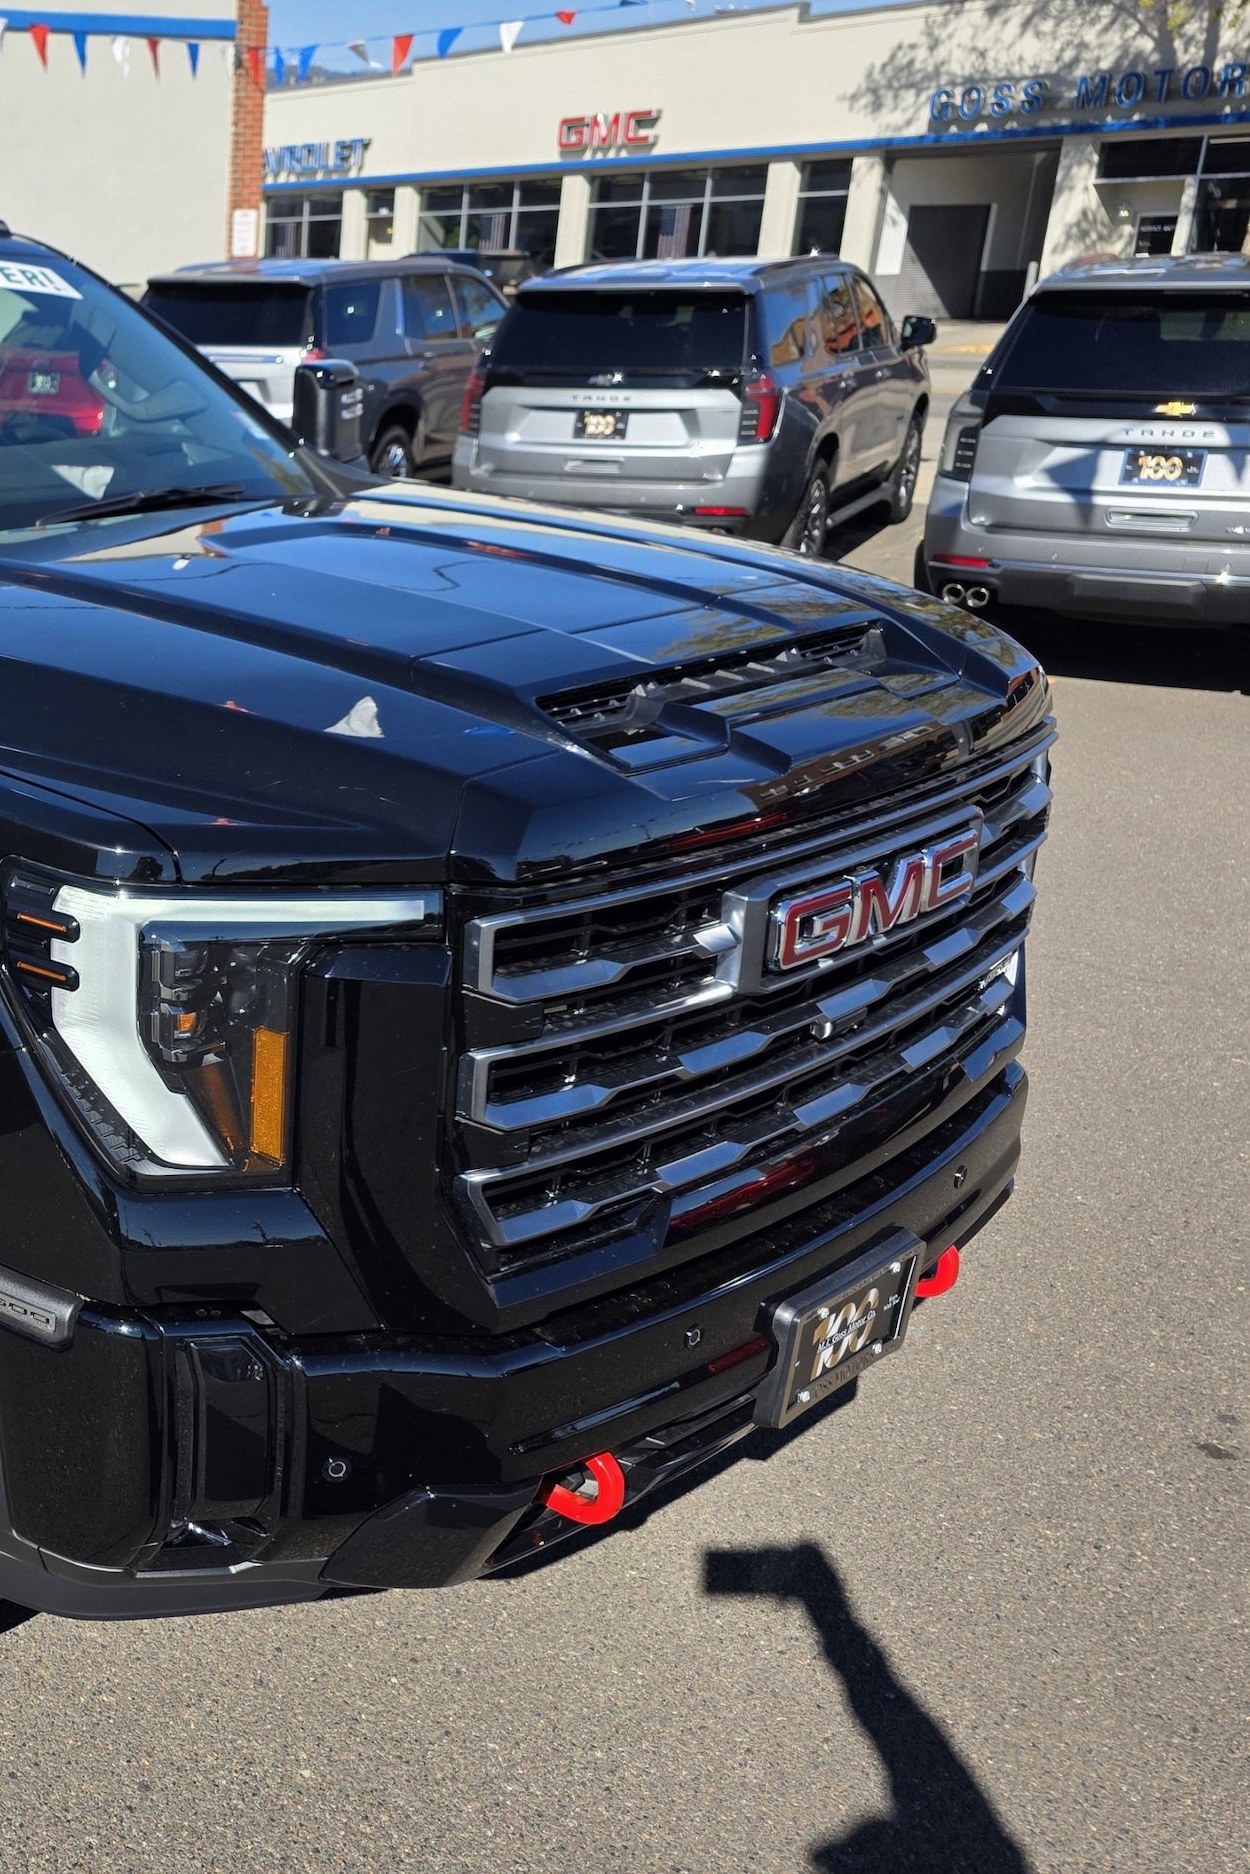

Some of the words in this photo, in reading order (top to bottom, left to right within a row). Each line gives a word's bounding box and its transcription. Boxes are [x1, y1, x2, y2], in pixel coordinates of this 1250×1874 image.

[929, 79, 1044, 122] GOSS
[1075, 63, 1248, 110] MOTOR
[558, 109, 654, 149] GMC
[264, 138, 372, 176] VROLET
[1121, 427, 1215, 439] TAHOE
[1138, 456, 1183, 481] 100
[769, 828, 979, 971] GMC
[810, 1287, 879, 1381] 100
